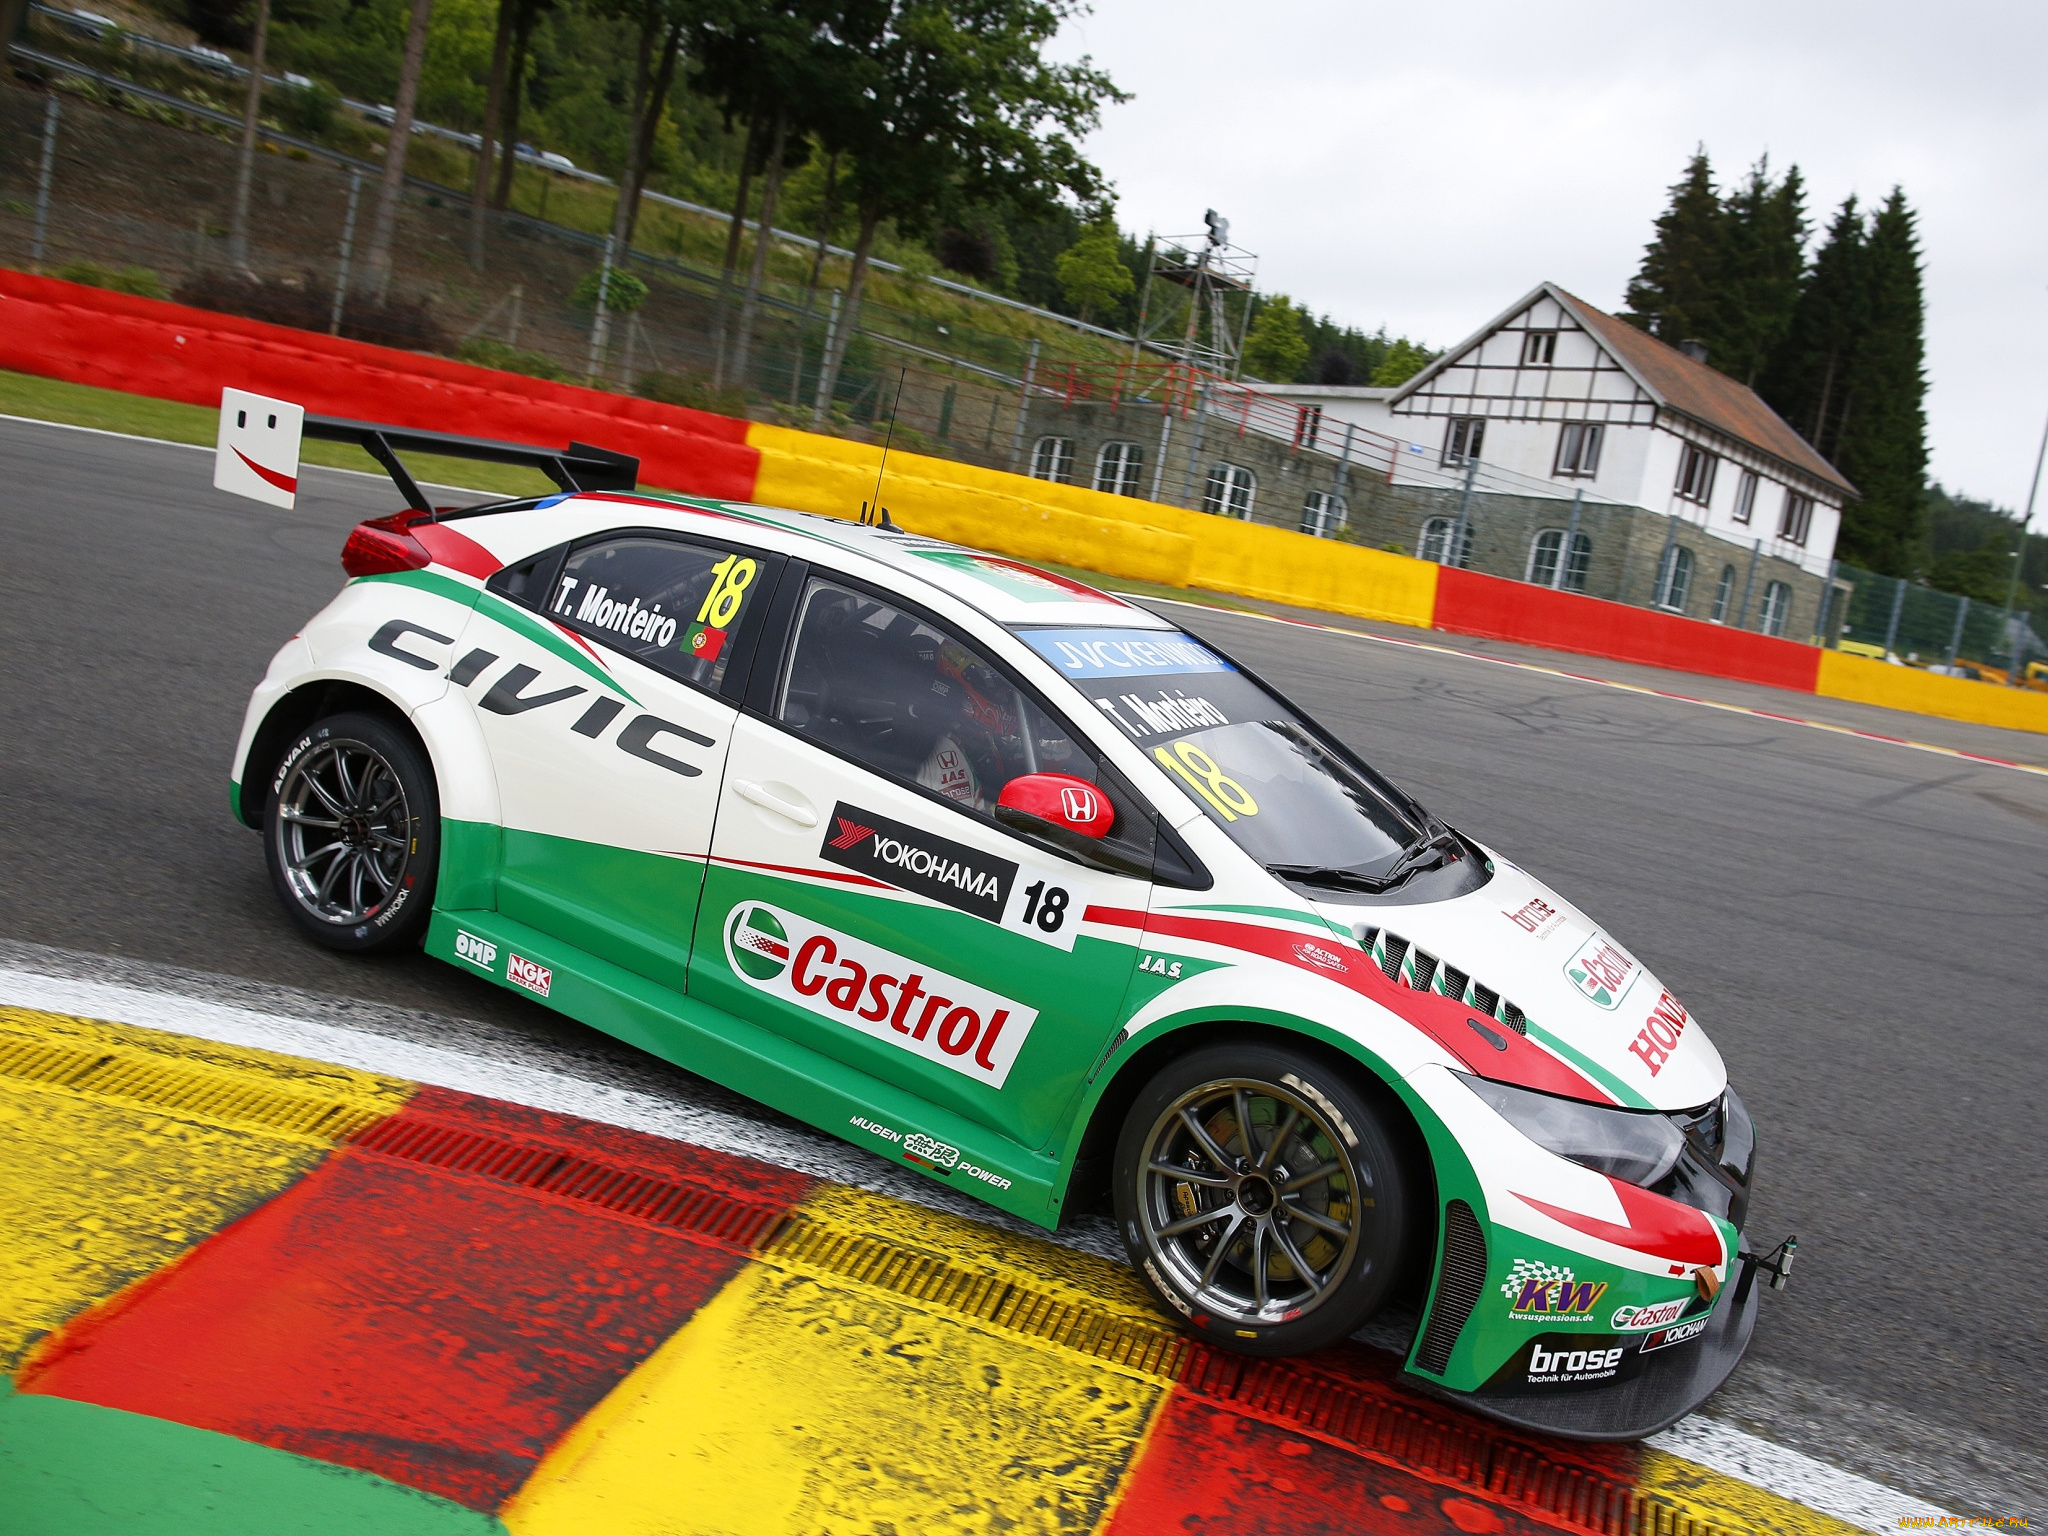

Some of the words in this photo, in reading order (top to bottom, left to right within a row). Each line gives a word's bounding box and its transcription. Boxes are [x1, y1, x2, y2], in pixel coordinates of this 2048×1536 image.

[554, 576, 578, 617] T.
[576, 584, 677, 648] Monteiro
[697, 554, 757, 629] 18
[368, 619, 716, 778] CIVIC
[1094, 697, 1151, 738] T.
[1119, 689, 1230, 735] Monteiro
[273, 736, 312, 795] ADVAN
[1153, 741, 1259, 823] 18
[873, 834, 998, 902] YOKOHAMA
[374, 888, 410, 928] YOKOHAMA
[1024, 880, 1070, 933] 18
[1501, 898, 1556, 933] brose
[456, 934, 496, 965] OMP
[1314, 947, 1342, 963] ACTION
[1581, 938, 1633, 992] Castrol
[508, 974, 527, 987] SPARK
[527, 983, 548, 996] PLUGS
[510, 956, 550, 988] NGK
[791, 935, 1011, 1072] Castrol
[849, 1115, 903, 1143] MUGEN
[957, 1161, 1012, 1190] POWER
[1508, 1310, 1594, 1322] kwsuspensions.de
[1513, 1280, 1608, 1313] KW
[1629, 1302, 1681, 1327] Castrol
[1527, 1374, 1559, 1383] Technik
[1560, 1373, 1573, 1382] für
[1573, 1369, 1617, 1381] Automobile
[1529, 1344, 1624, 1373] brose
